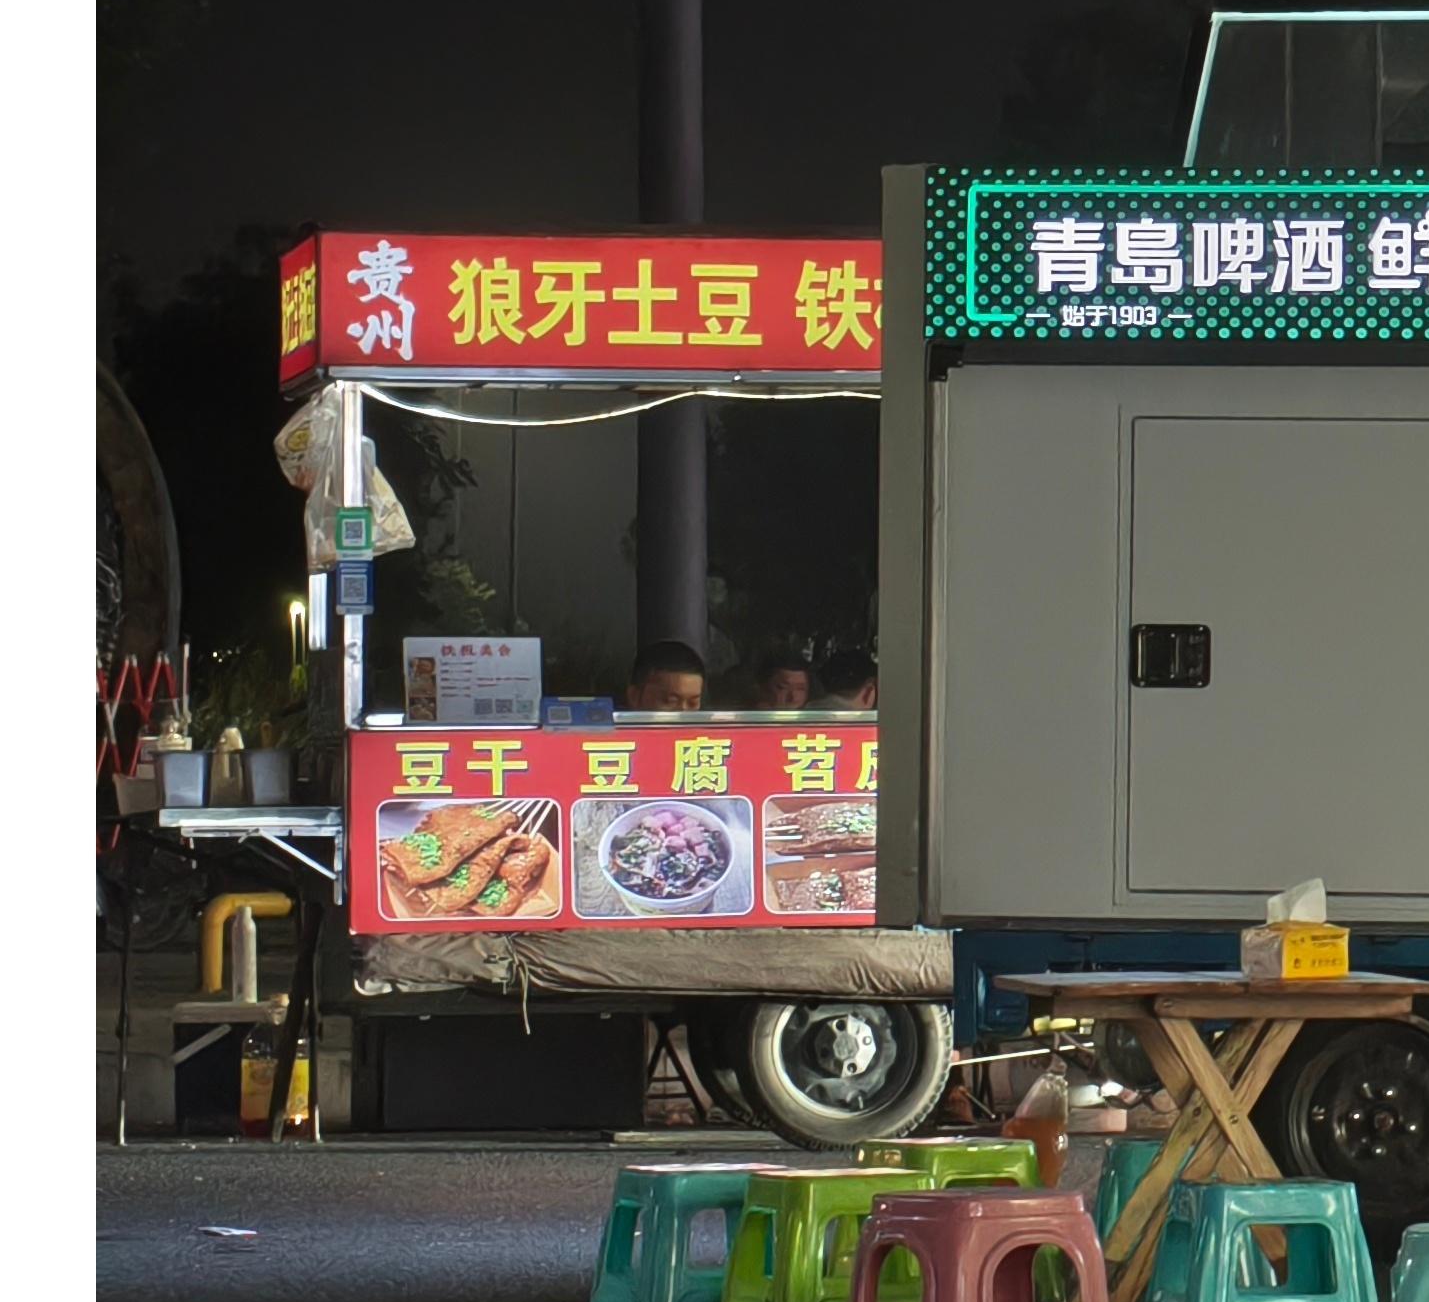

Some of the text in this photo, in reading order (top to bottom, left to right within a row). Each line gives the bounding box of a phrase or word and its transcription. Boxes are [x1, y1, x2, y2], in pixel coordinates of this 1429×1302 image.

[346, 239, 416, 362] 贵州
[447, 256, 883, 350] 狼牙土豆 铁
[1061, 305, 1158, 328] 始于1903
[392, 740, 528, 796] 豆干
[580, 736, 732, 795] 豆腐
